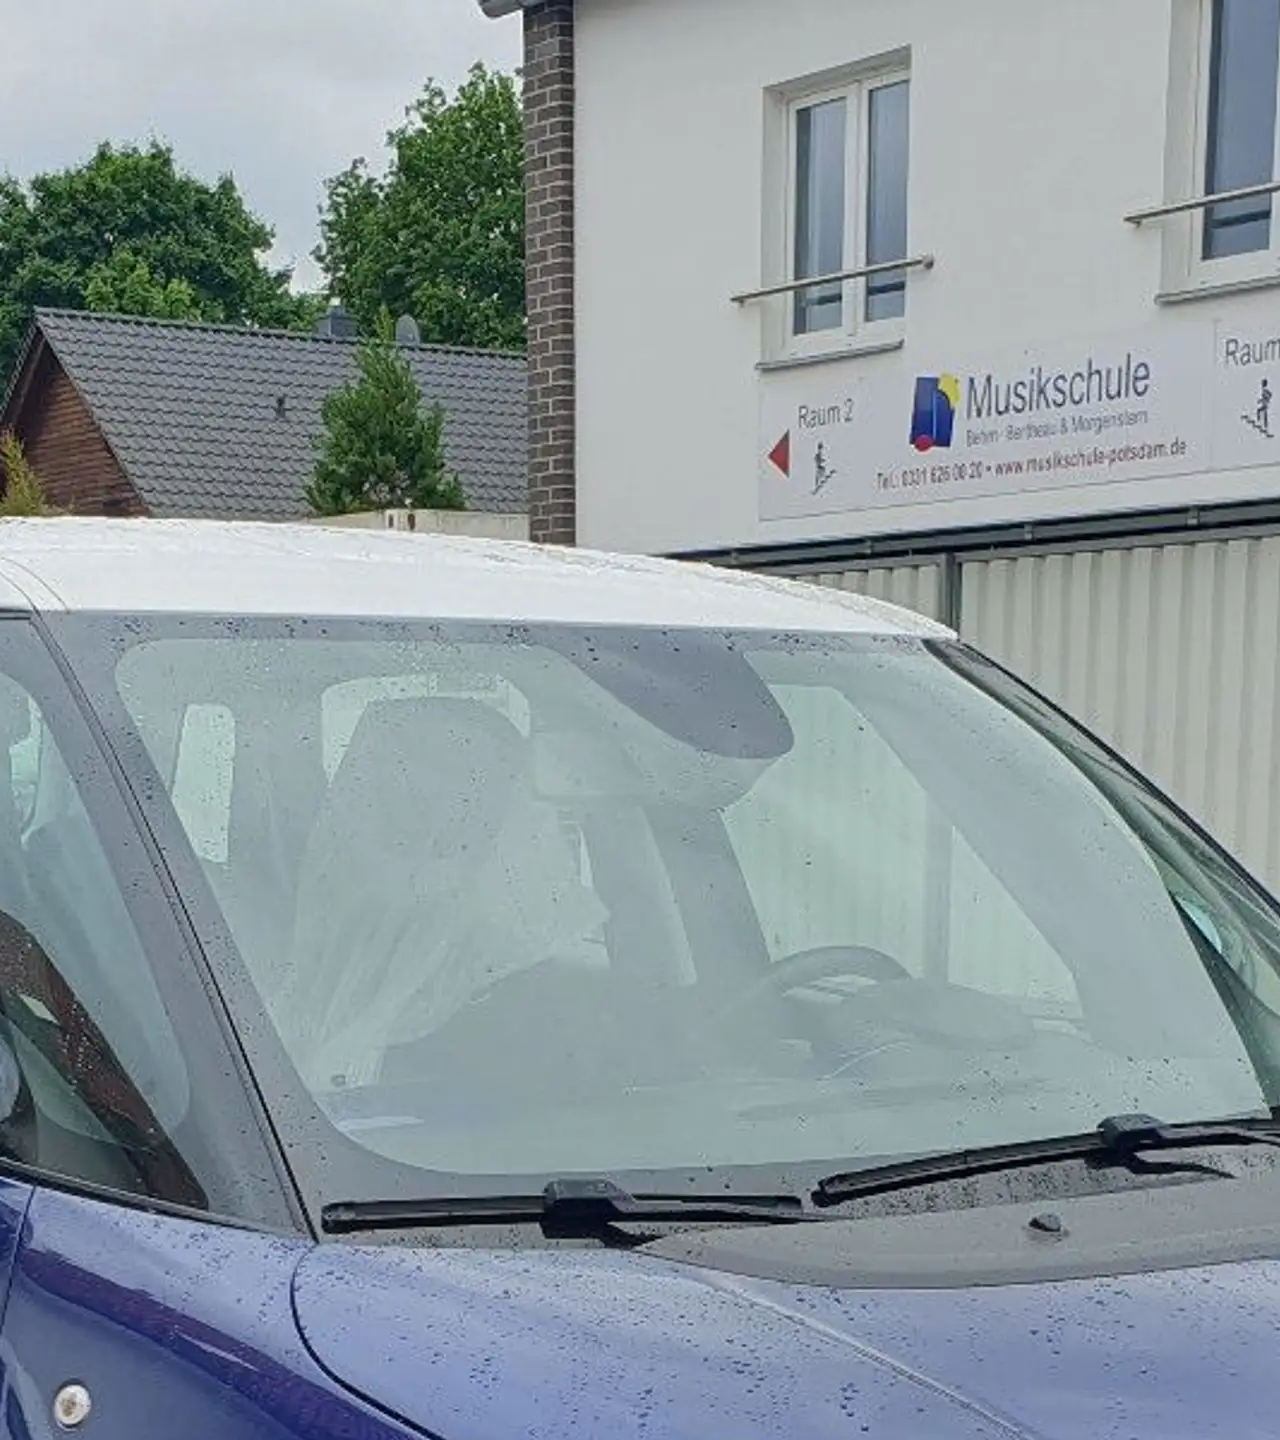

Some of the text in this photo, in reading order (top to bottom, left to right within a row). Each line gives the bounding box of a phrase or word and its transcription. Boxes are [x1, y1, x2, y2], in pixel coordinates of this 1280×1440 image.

[966, 352, 1151, 421] Musikschule
[798, 397, 854, 429] Raum 2
